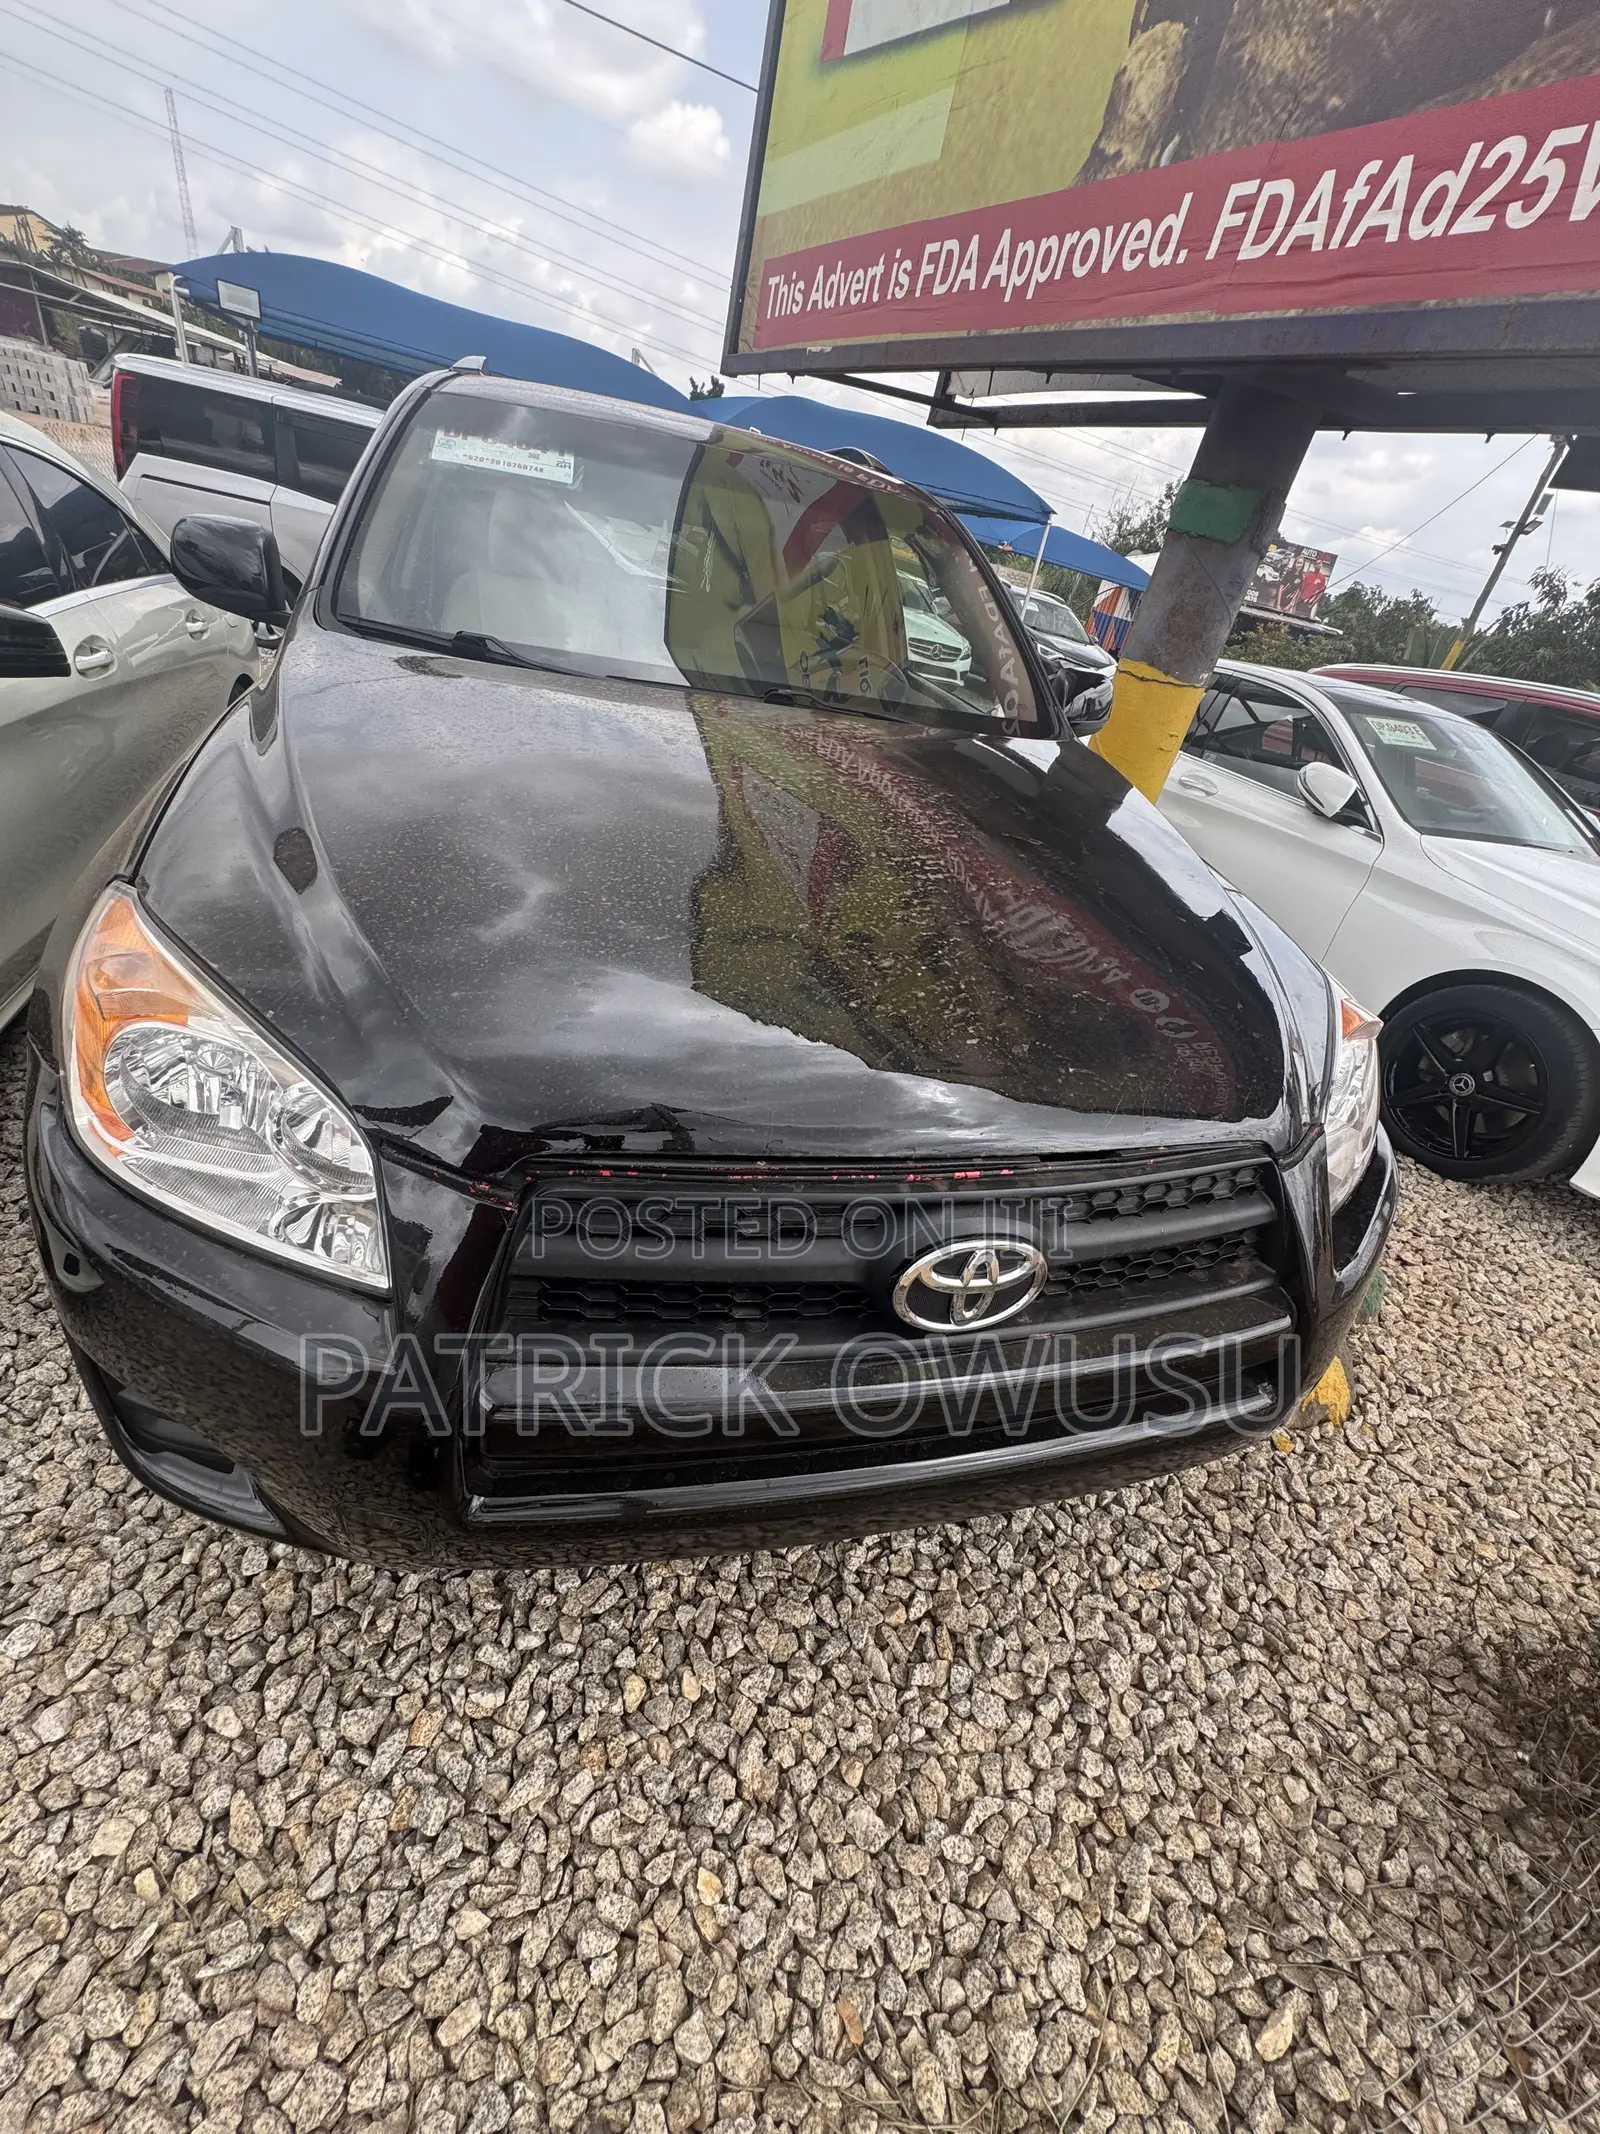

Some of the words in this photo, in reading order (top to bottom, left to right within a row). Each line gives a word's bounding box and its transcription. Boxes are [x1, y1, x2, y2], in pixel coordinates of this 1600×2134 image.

[766, 276, 804, 319] This
[806, 252, 885, 312] Advert
[886, 248, 912, 300] is
[915, 234, 980, 298] FDA
[981, 191, 1194, 303] Approved.
